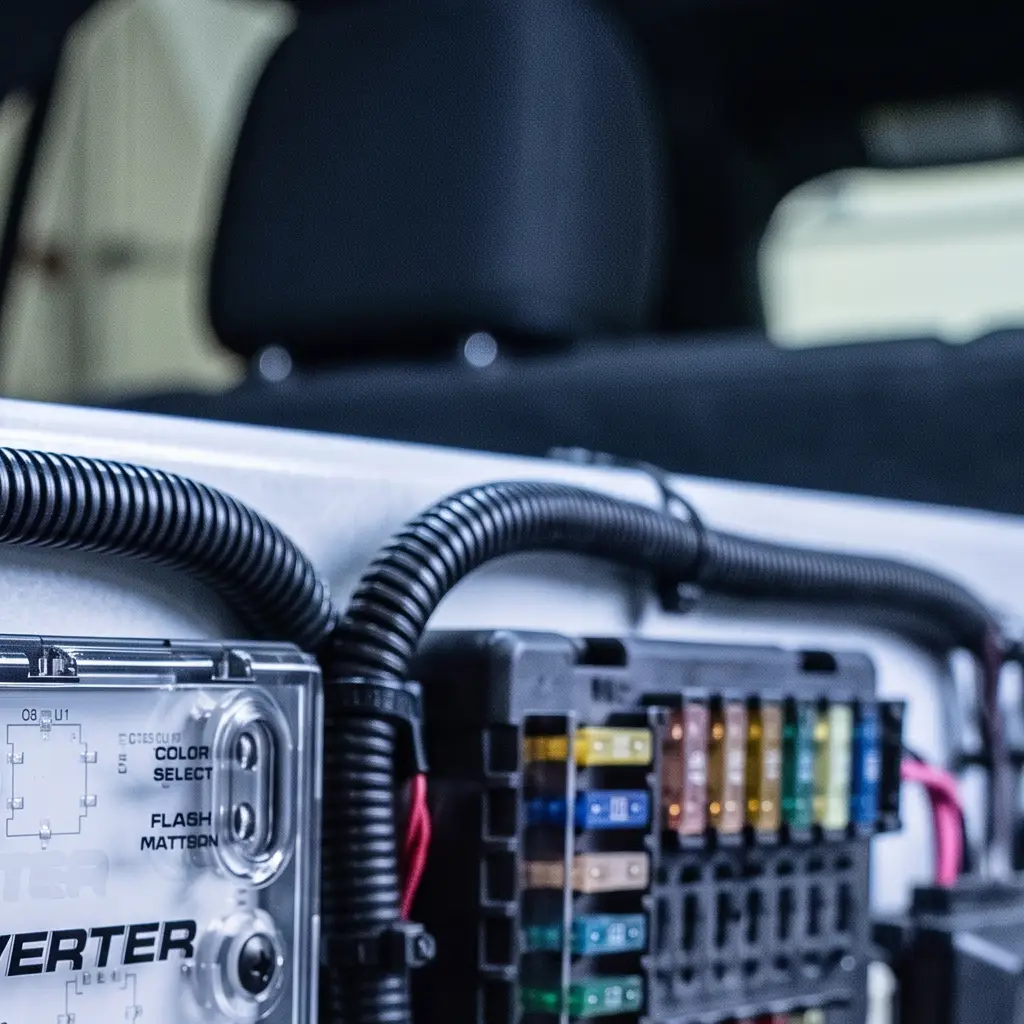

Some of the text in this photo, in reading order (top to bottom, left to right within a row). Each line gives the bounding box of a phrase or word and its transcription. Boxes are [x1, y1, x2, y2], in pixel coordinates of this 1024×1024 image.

[154, 746, 209, 761] COLOR
[153, 766, 213, 782] SELECT
[150, 811, 212, 829] FLASH
